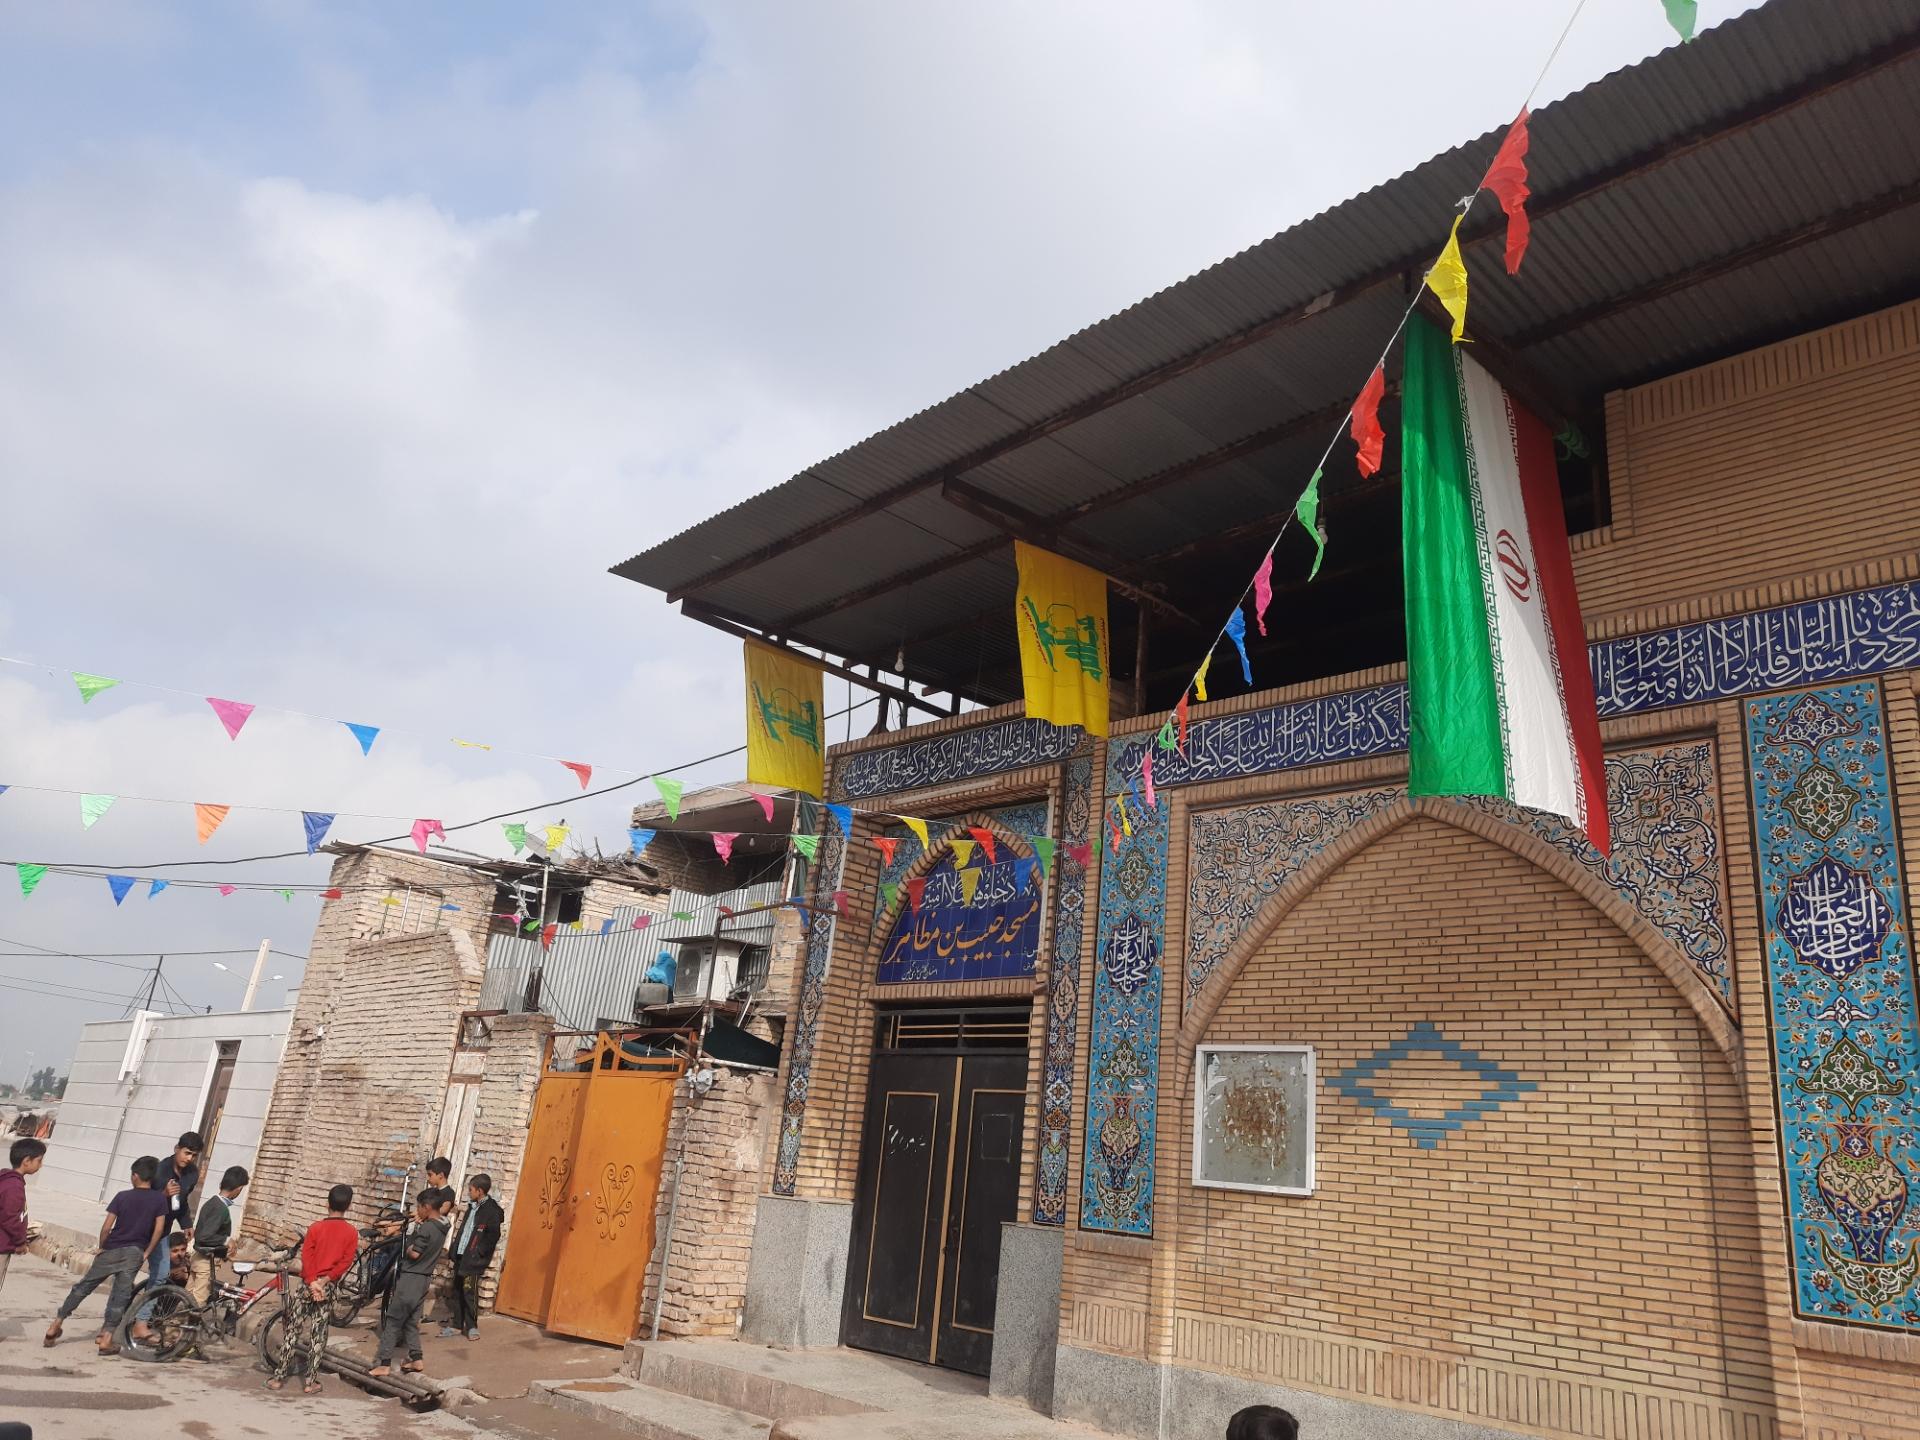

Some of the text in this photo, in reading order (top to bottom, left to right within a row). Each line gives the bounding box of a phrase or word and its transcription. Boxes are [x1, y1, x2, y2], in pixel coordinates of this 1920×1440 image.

[884, 911, 941, 965] مظاهر
[936, 920, 965, 965] بن
[996, 900, 1039, 957] مسجد
